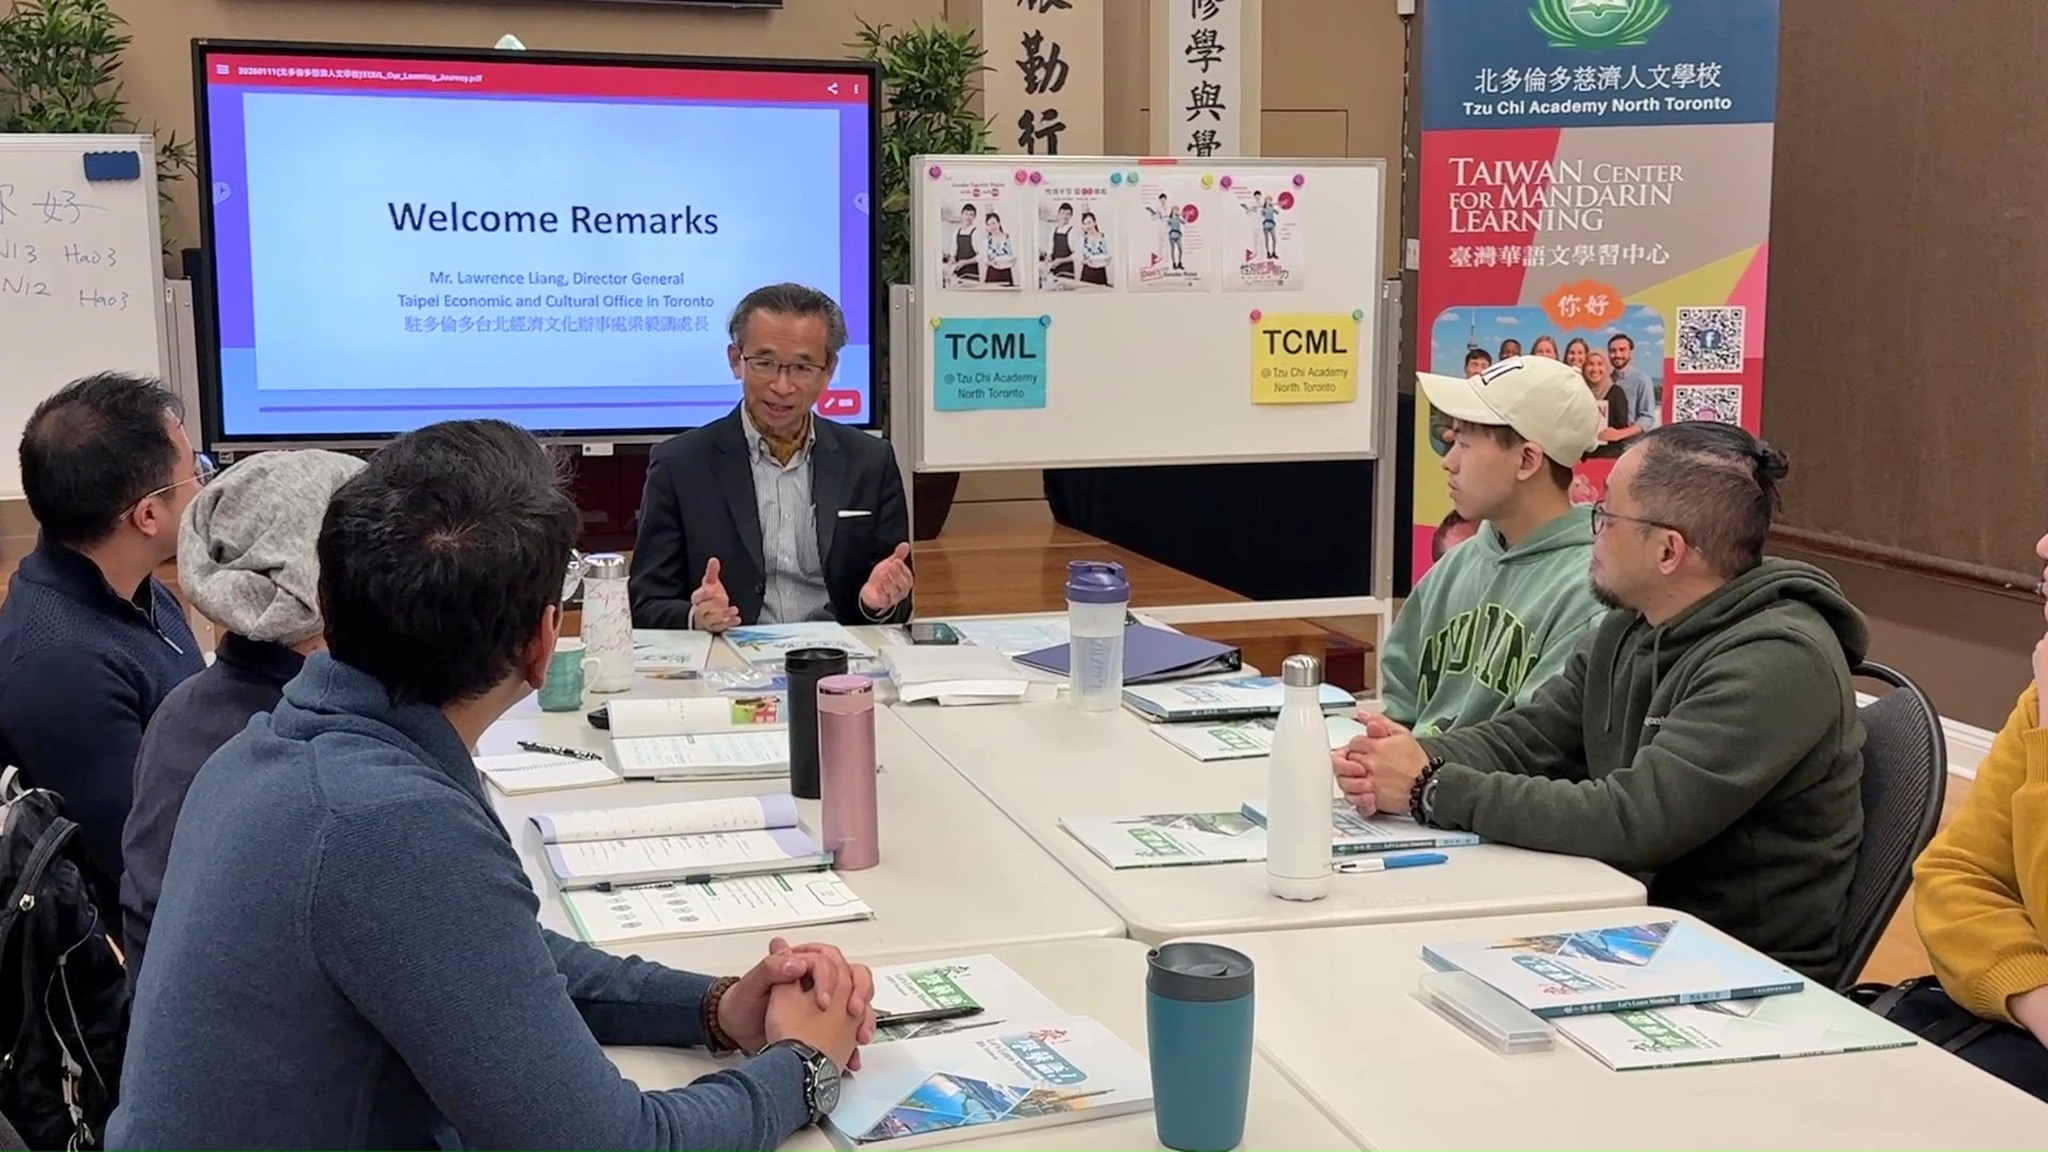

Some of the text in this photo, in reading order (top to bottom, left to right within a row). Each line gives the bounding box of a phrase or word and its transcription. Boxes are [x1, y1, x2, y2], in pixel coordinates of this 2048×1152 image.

[1474, 62, 1722, 94] 北多倫多慈濟人文學校
[1462, 96, 1732, 116] Tzu Chi Academy North Toronto
[1449, 157, 1685, 187] TAIWAN CENTER
[1449, 182, 1674, 210] FOR MANDARIN
[388, 201, 719, 235] Welcome Remarks
[1449, 209, 1604, 233] LEARNING
[1448, 243, 1670, 269] 臺灣華語文學習中心
[430, 271, 685, 287] Mr. Lawrence Liang, Director General
[397, 294, 715, 310] Taipei Economic and Cultural Office in Toronto
[1557, 294, 1610, 318] 你好
[945, 333, 1037, 360] TCML
[1262, 329, 1347, 355] TCML
[975, 372, 991, 383] Chi
[993, 372, 1038, 385] Academy
[1290, 367, 1305, 378] Chi
[1307, 367, 1349, 379] Academy
[958, 387, 1025, 399] North Toronto
[1274, 382, 1336, 393] North Toronto
